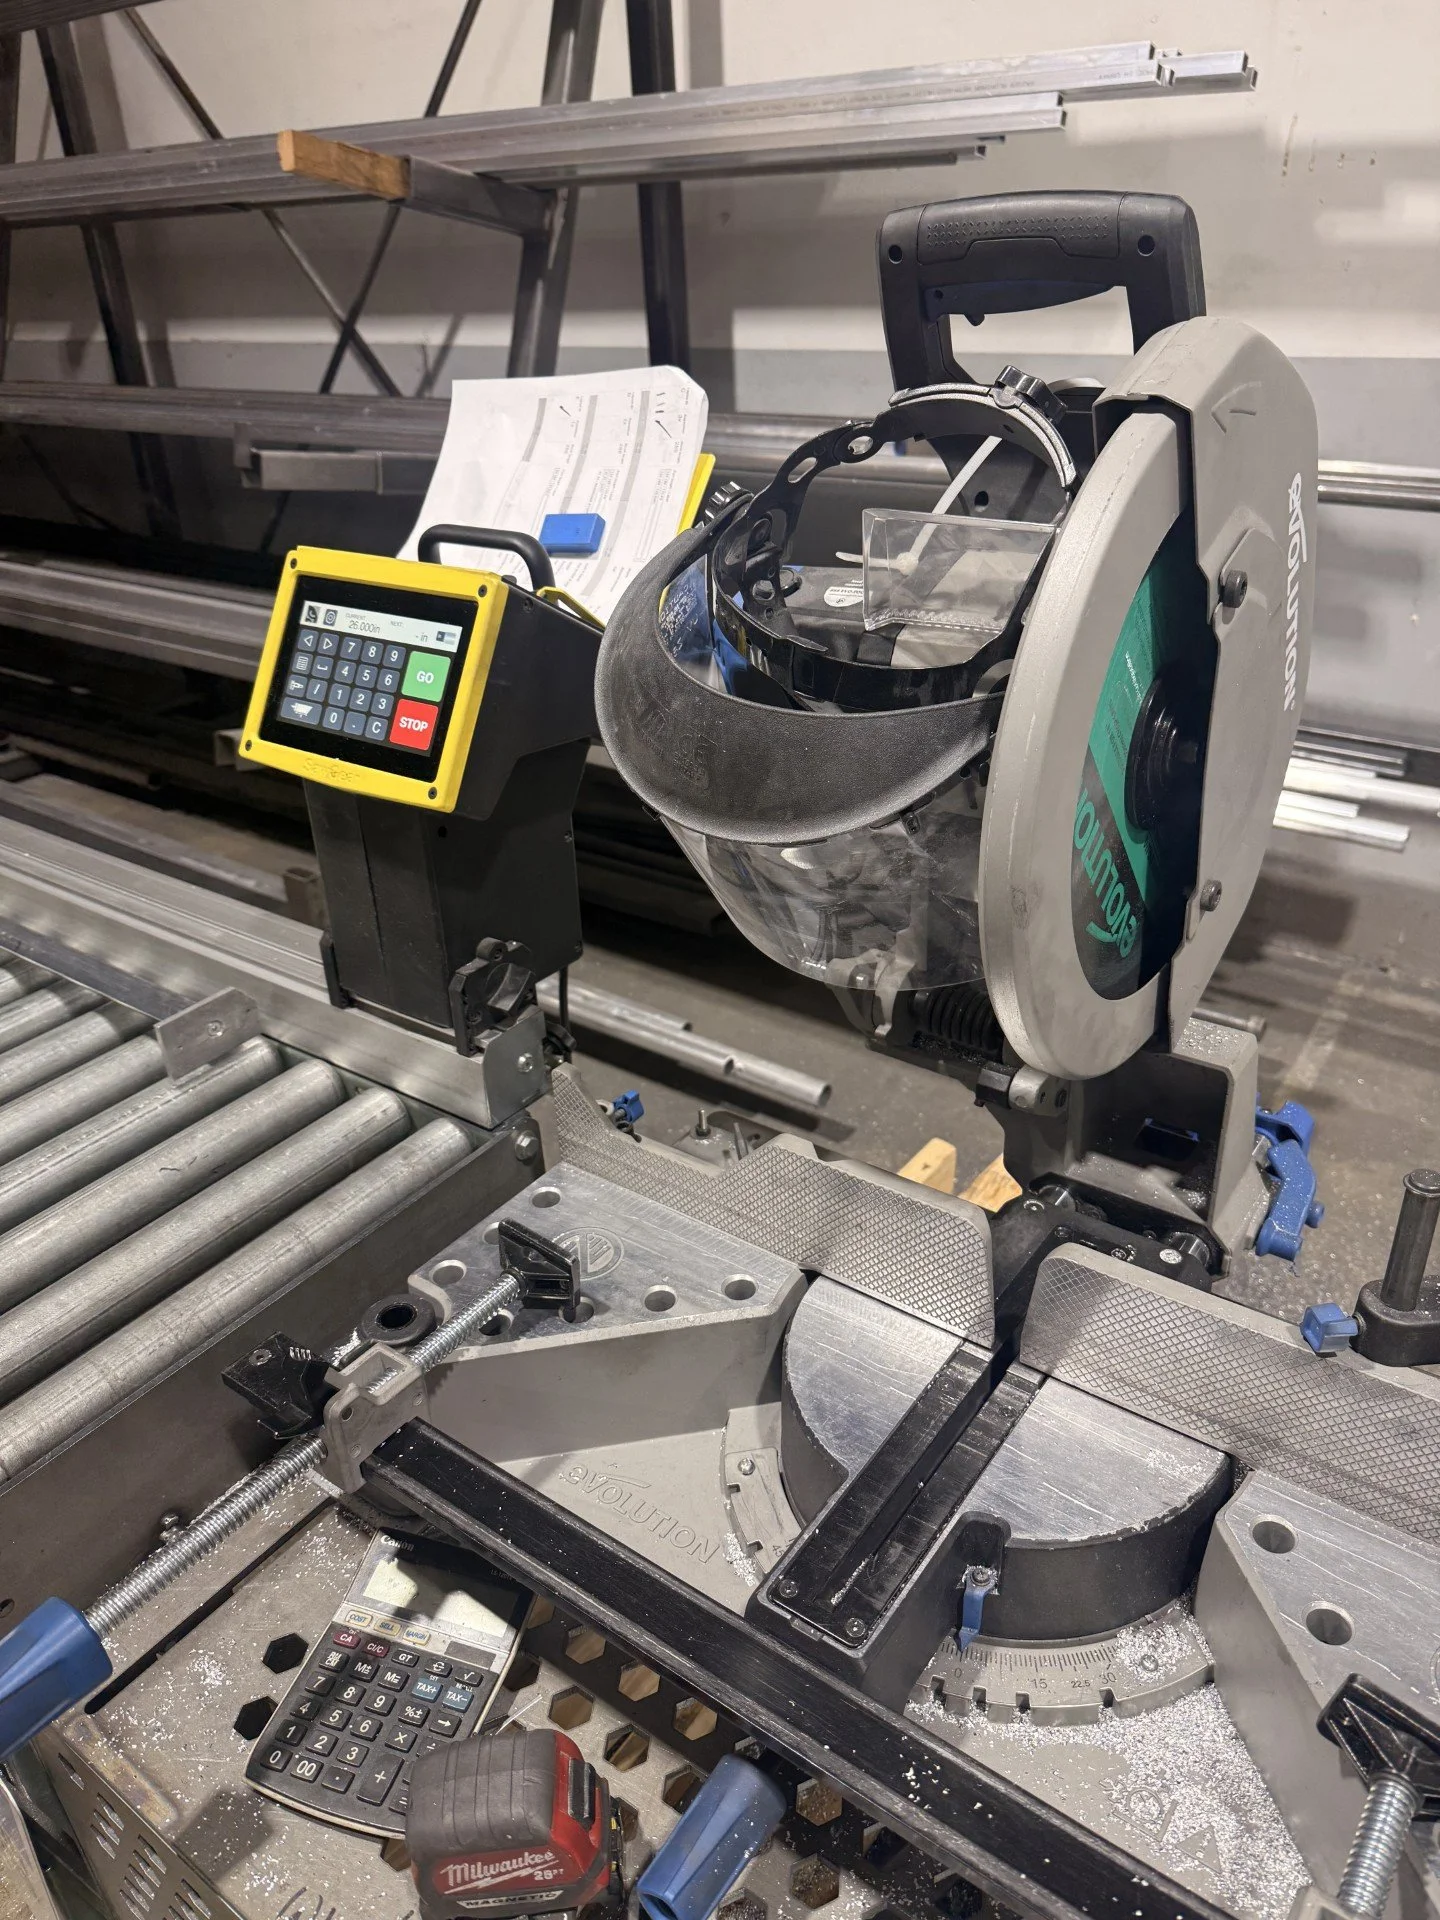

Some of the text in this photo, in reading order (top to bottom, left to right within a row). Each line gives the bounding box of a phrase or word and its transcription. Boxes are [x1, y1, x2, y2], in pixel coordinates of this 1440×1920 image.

[348, 642, 398, 662] 7 8 9
[341, 666, 393, 686] 4 5 6
[416, 671, 434, 684] GO
[337, 689, 343, 700] 1
[356, 693, 365, 705] 2
[378, 698, 387, 710] 3
[330, 712, 338, 724] 0
[372, 721, 381, 734] C
[399, 716, 429, 732] STOP
[380, 1535, 415, 1552] Canon
[349, 1613, 427, 1641] COST SELL MARGIN
[339, 1634, 353, 1643] CA
[398, 1653, 413, 1663] GT
[953, 1667, 1117, 1689] 0 15 22.5 30
[313, 1676, 325, 1689] 7
[343, 1686, 355, 1699] 8
[373, 1695, 386, 1708] 9
[416, 1682, 436, 1694] TAX+
[300, 1701, 312, 1714] 4
[329, 1709, 342, 1722] 5
[359, 1719, 372, 1733] 6
[286, 1725, 296, 1738] 1
[313, 1735, 328, 1750] 2
[346, 1747, 359, 1760] 3
[269, 1750, 282, 1764] 0
[296, 1760, 317, 1777] 00
[440, 1849, 556, 1886] Milwaukee
[465, 1891, 558, 1907] MAGNETIC
